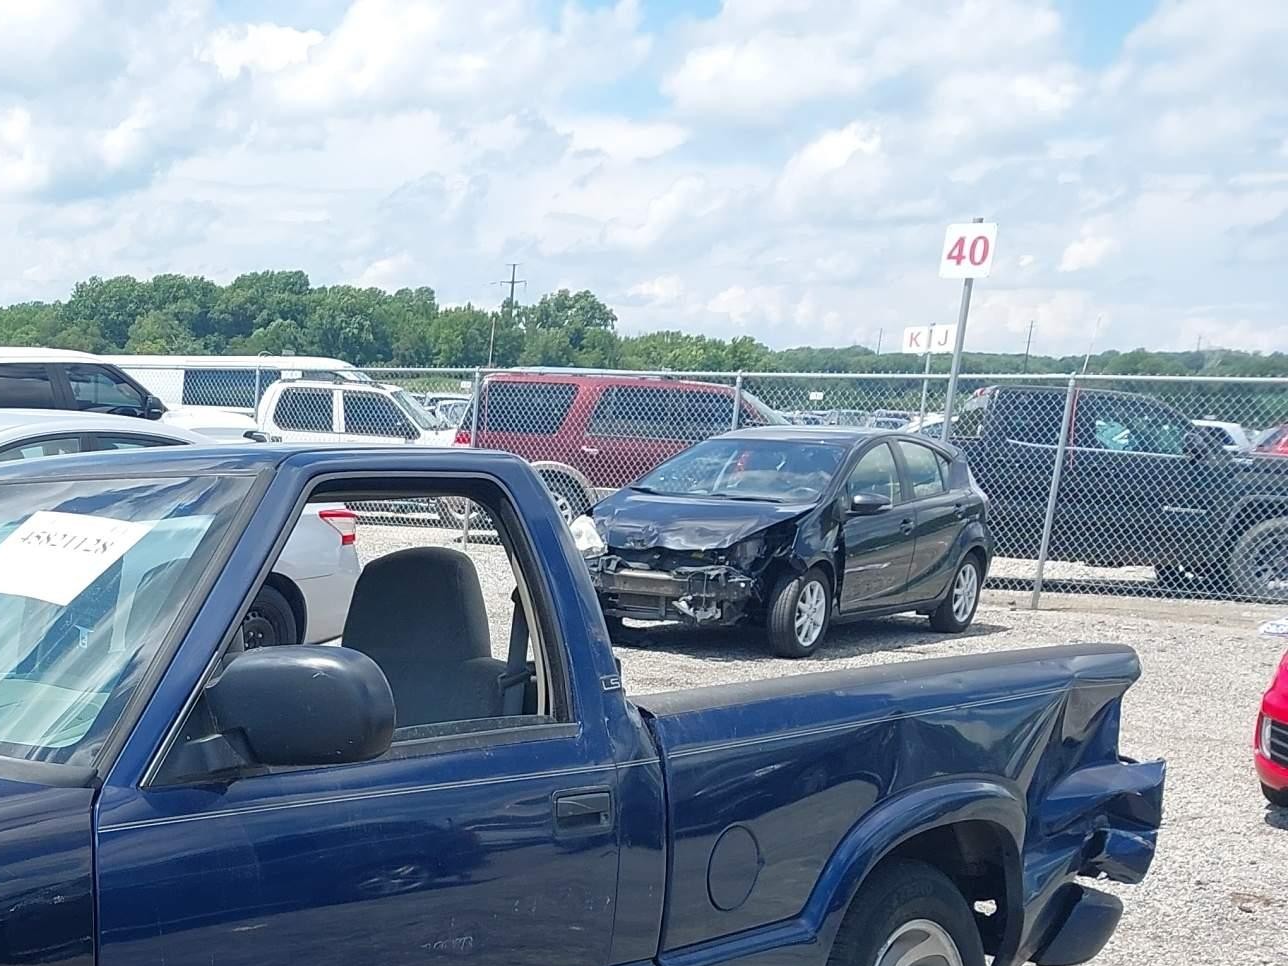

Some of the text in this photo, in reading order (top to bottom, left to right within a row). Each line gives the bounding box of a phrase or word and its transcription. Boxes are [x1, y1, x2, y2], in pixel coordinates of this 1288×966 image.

[946, 235, 990, 266] 40
[909, 329, 949, 348] K J
[601, 678, 621, 691] LS
